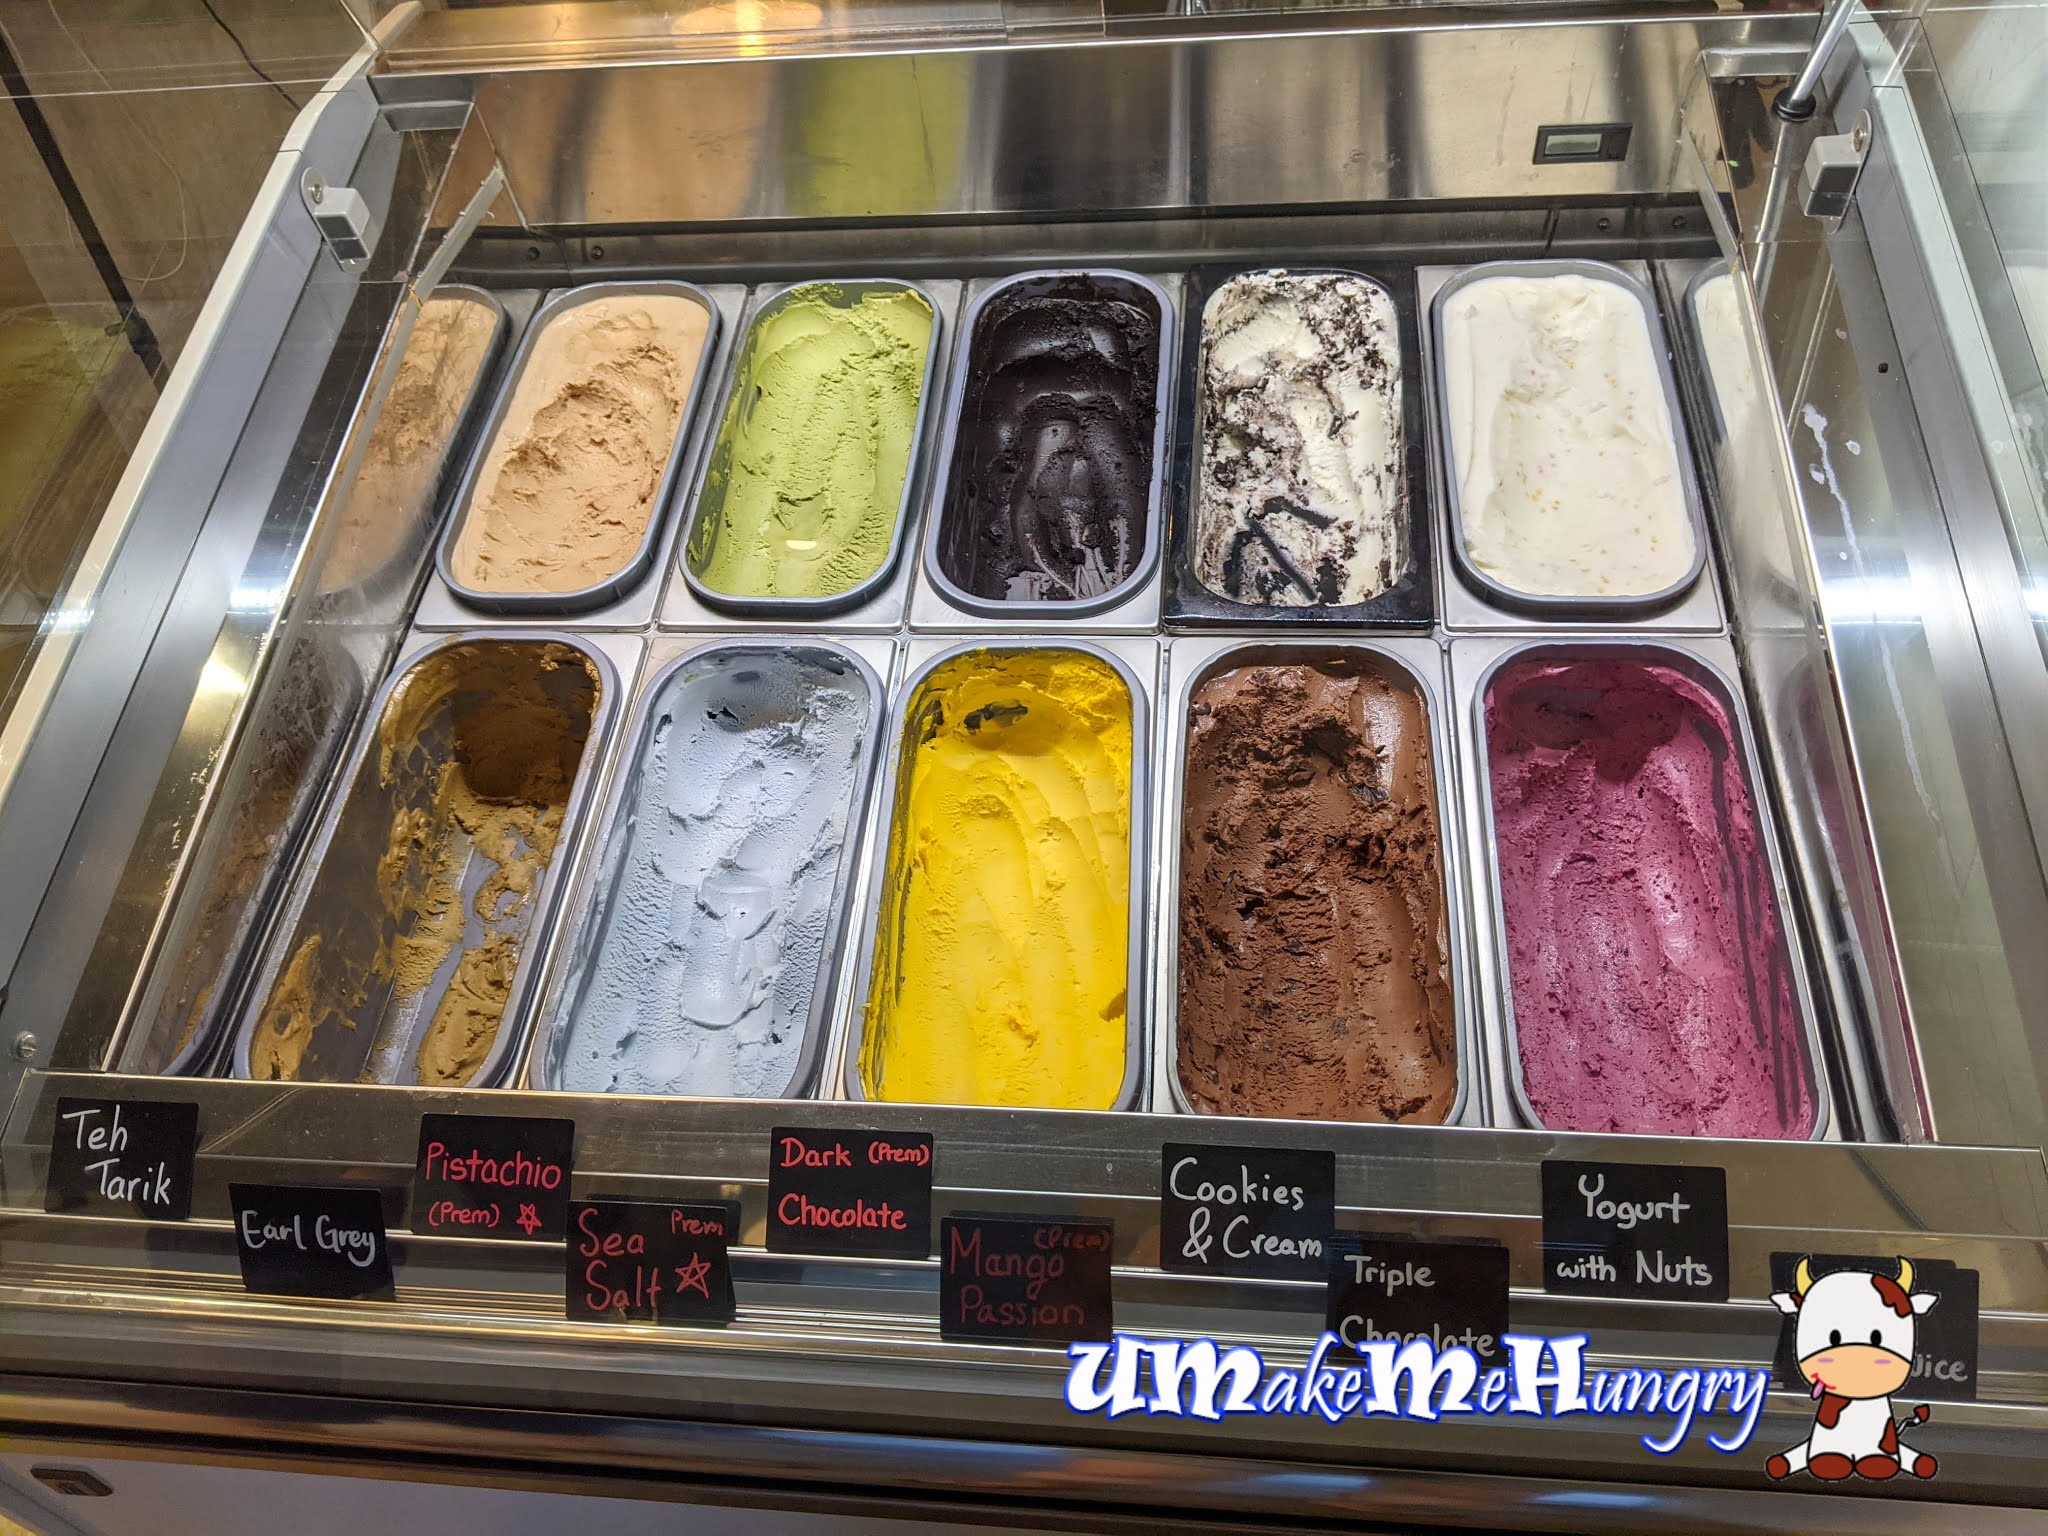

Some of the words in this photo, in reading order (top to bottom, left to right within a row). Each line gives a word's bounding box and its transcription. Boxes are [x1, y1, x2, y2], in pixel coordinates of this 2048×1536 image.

[63, 1106, 127, 1152] Teh
[780, 1137, 851, 1168] Dark
[868, 1140, 930, 1166] (Prem)
[84, 1158, 172, 1205] Tarik
[425, 1142, 562, 1190] Pistachio
[1169, 1156, 1304, 1209] Cookies
[429, 1202, 500, 1228] (Prem)
[778, 1193, 907, 1231] Chocolate
[1577, 1173, 1691, 1230] Yogurt
[242, 1210, 304, 1251] Earl
[315, 1214, 376, 1267] Grey
[578, 1207, 645, 1258] Sea
[671, 1208, 723, 1236] Prem
[1181, 1206, 1210, 1264] &
[1222, 1217, 1323, 1260] Cream
[585, 1259, 662, 1311] Salt
[949, 1226, 1065, 1301] Mango
[1343, 1254, 1436, 1297] Triple
[1556, 1256, 1617, 1284] with
[1635, 1251, 1713, 1286] Nuts
[960, 1284, 1085, 1326] Passion
